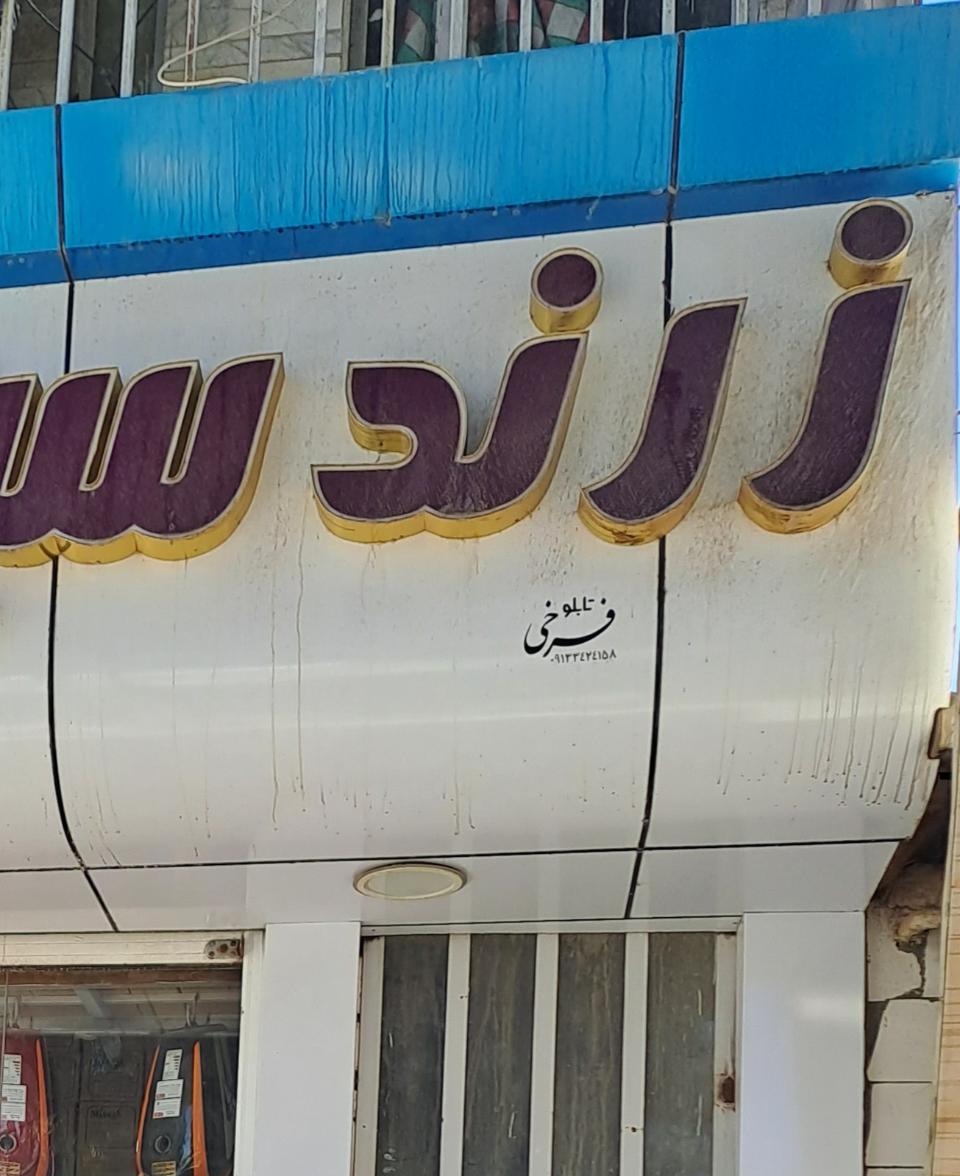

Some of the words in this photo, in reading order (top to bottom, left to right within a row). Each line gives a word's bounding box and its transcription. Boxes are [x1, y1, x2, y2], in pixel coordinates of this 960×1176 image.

[311, 199, 914, 544] زرند
[523, 597, 616, 658] فرخی
[562, 596, 595, 618] تابلو
